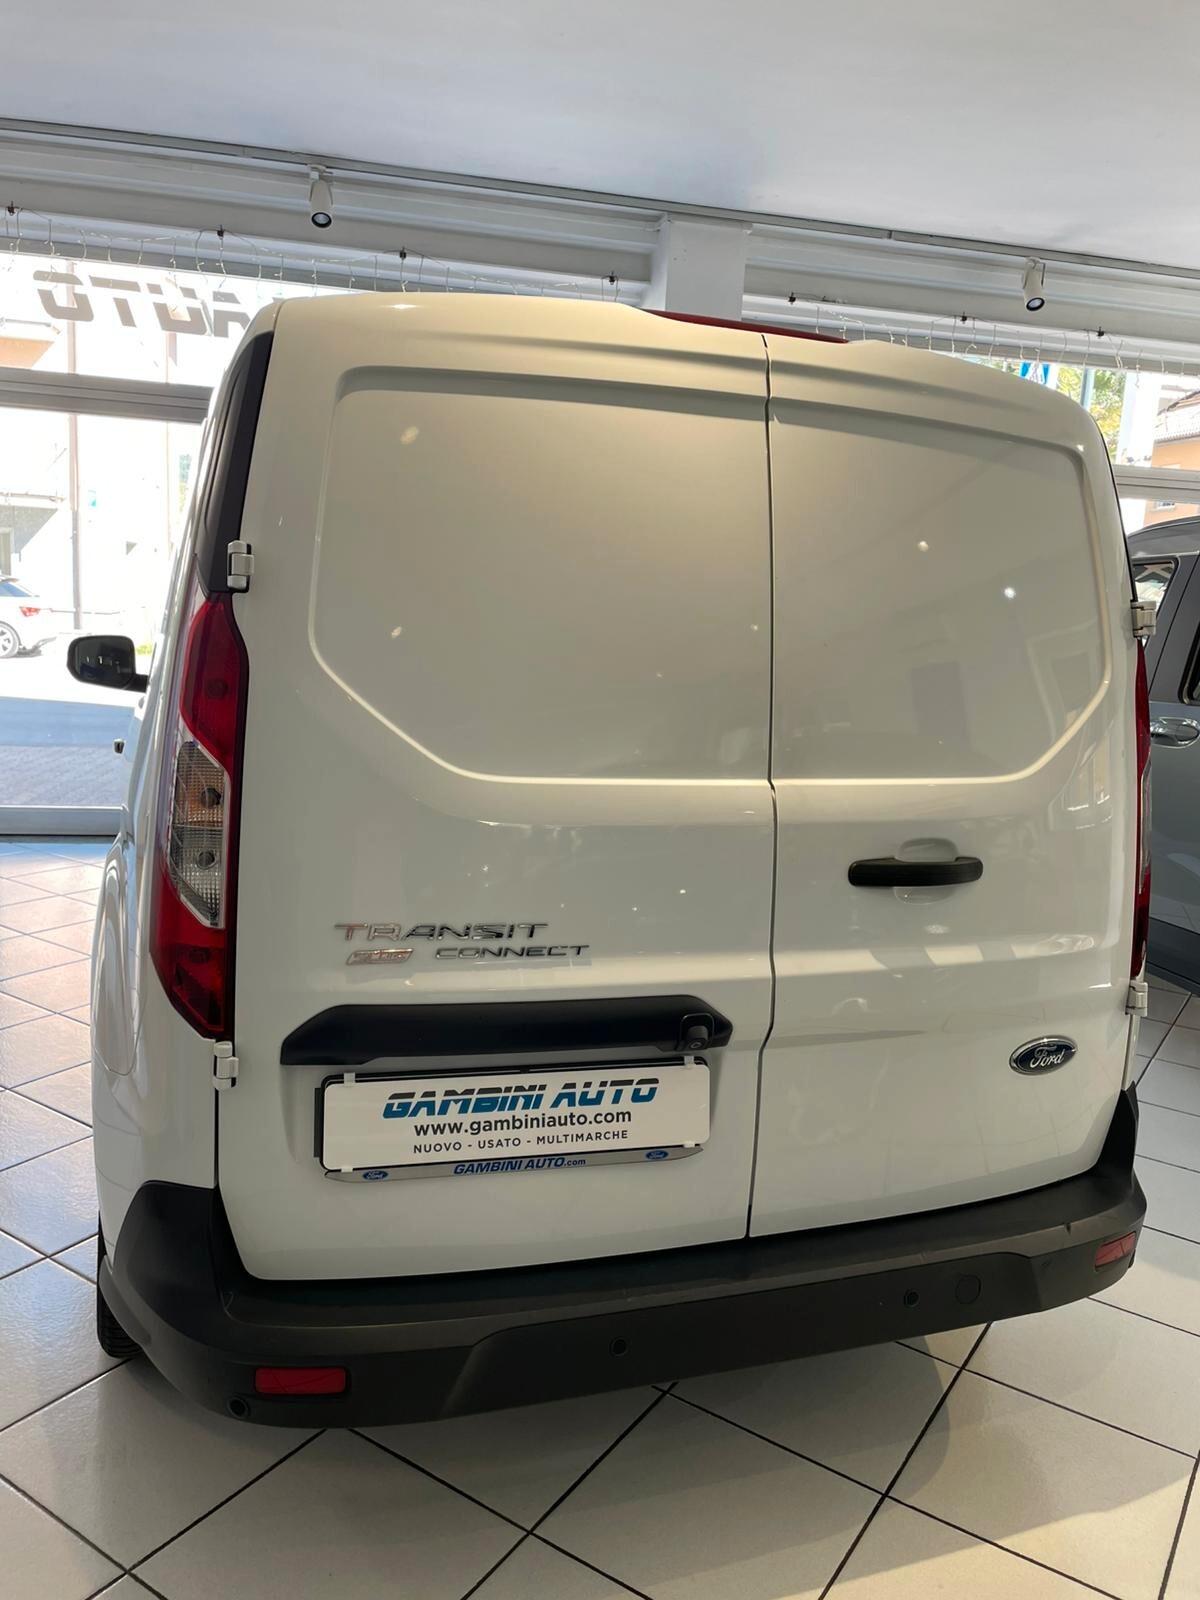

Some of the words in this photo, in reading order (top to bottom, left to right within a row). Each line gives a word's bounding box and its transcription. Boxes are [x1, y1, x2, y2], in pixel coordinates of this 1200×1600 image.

[334, 923, 548, 941] TRANSIT
[435, 945, 590, 960] CONNECT
[1029, 1046, 1066, 1068] Ford
[382, 1084, 547, 1119] GAMBINI
[550, 1078, 659, 1109] AUTO
[414, 1111, 632, 1136] www.gambiniauto.com
[413, 1142, 461, 1154] NUOVO
[478, 1138, 521, 1149] USATO
[536, 1130, 628, 1145] MULTIMARCHE
[453, 1160, 522, 1175] GAMBINI
